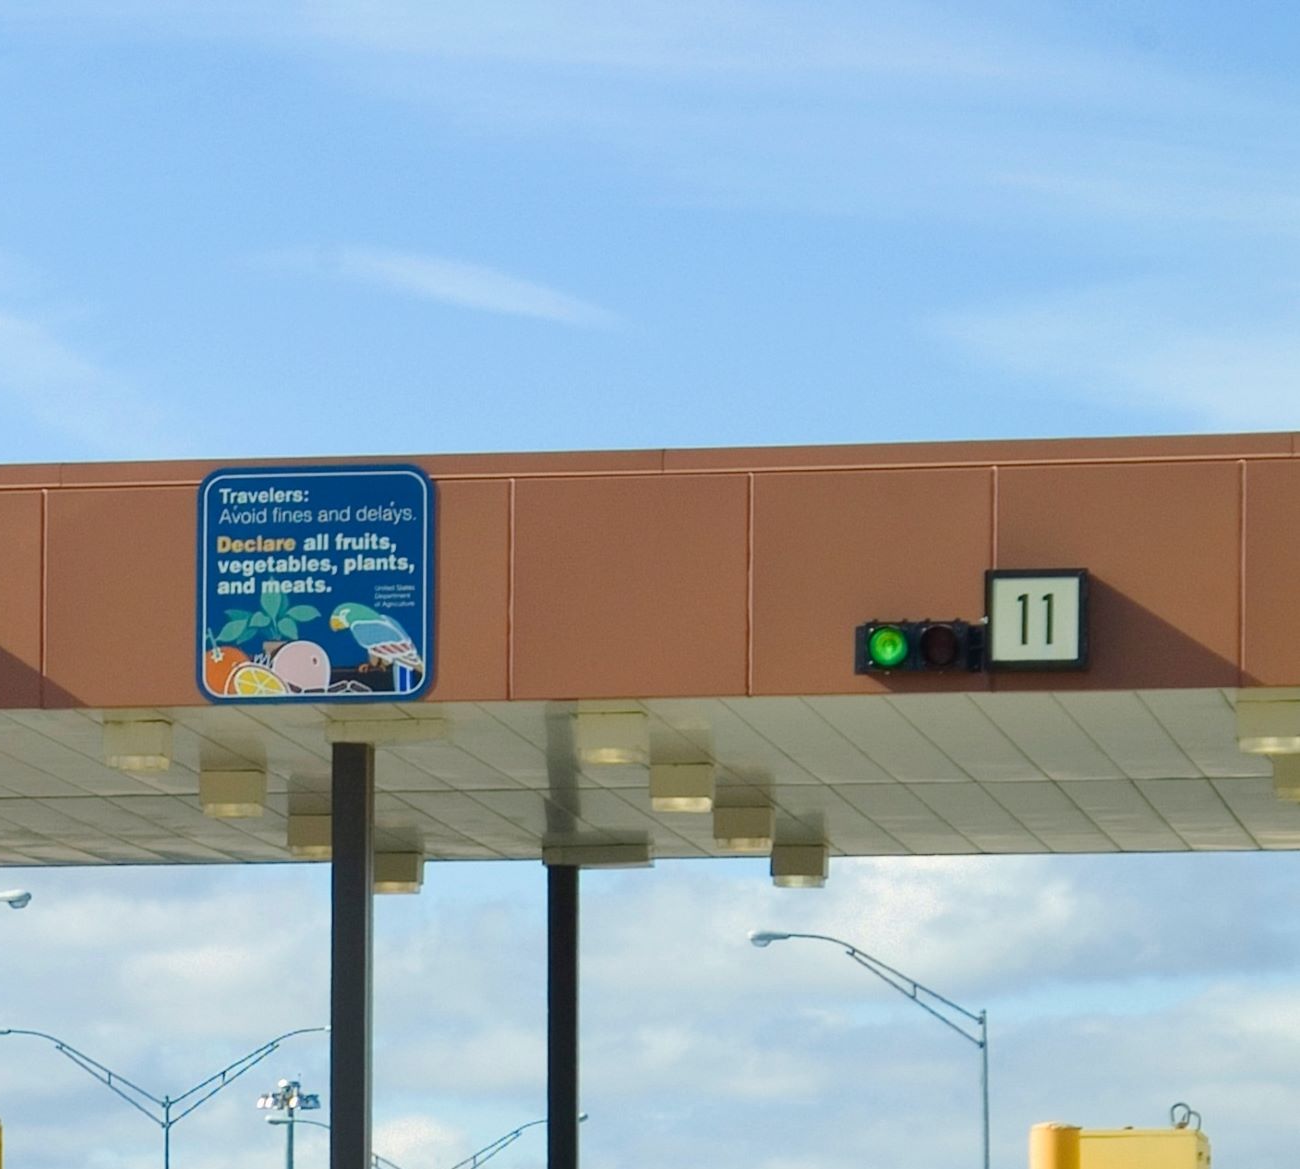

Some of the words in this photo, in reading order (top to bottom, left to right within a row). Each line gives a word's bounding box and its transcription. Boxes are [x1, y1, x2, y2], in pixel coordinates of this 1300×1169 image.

[219, 488, 309, 504] Travelers:
[218, 508, 268, 524] Avoid
[273, 507, 312, 523] fines
[318, 506, 351, 523] and
[356, 505, 417, 525] delays.
[216, 534, 296, 553] Declare
[303, 533, 329, 551] all
[335, 532, 397, 552] fruits,
[217, 555, 338, 577] vegetables,
[343, 554, 415, 575] plants,
[217, 578, 256, 595] and
[261, 577, 332, 594] meats.
[1017, 592, 1054, 646] 11
